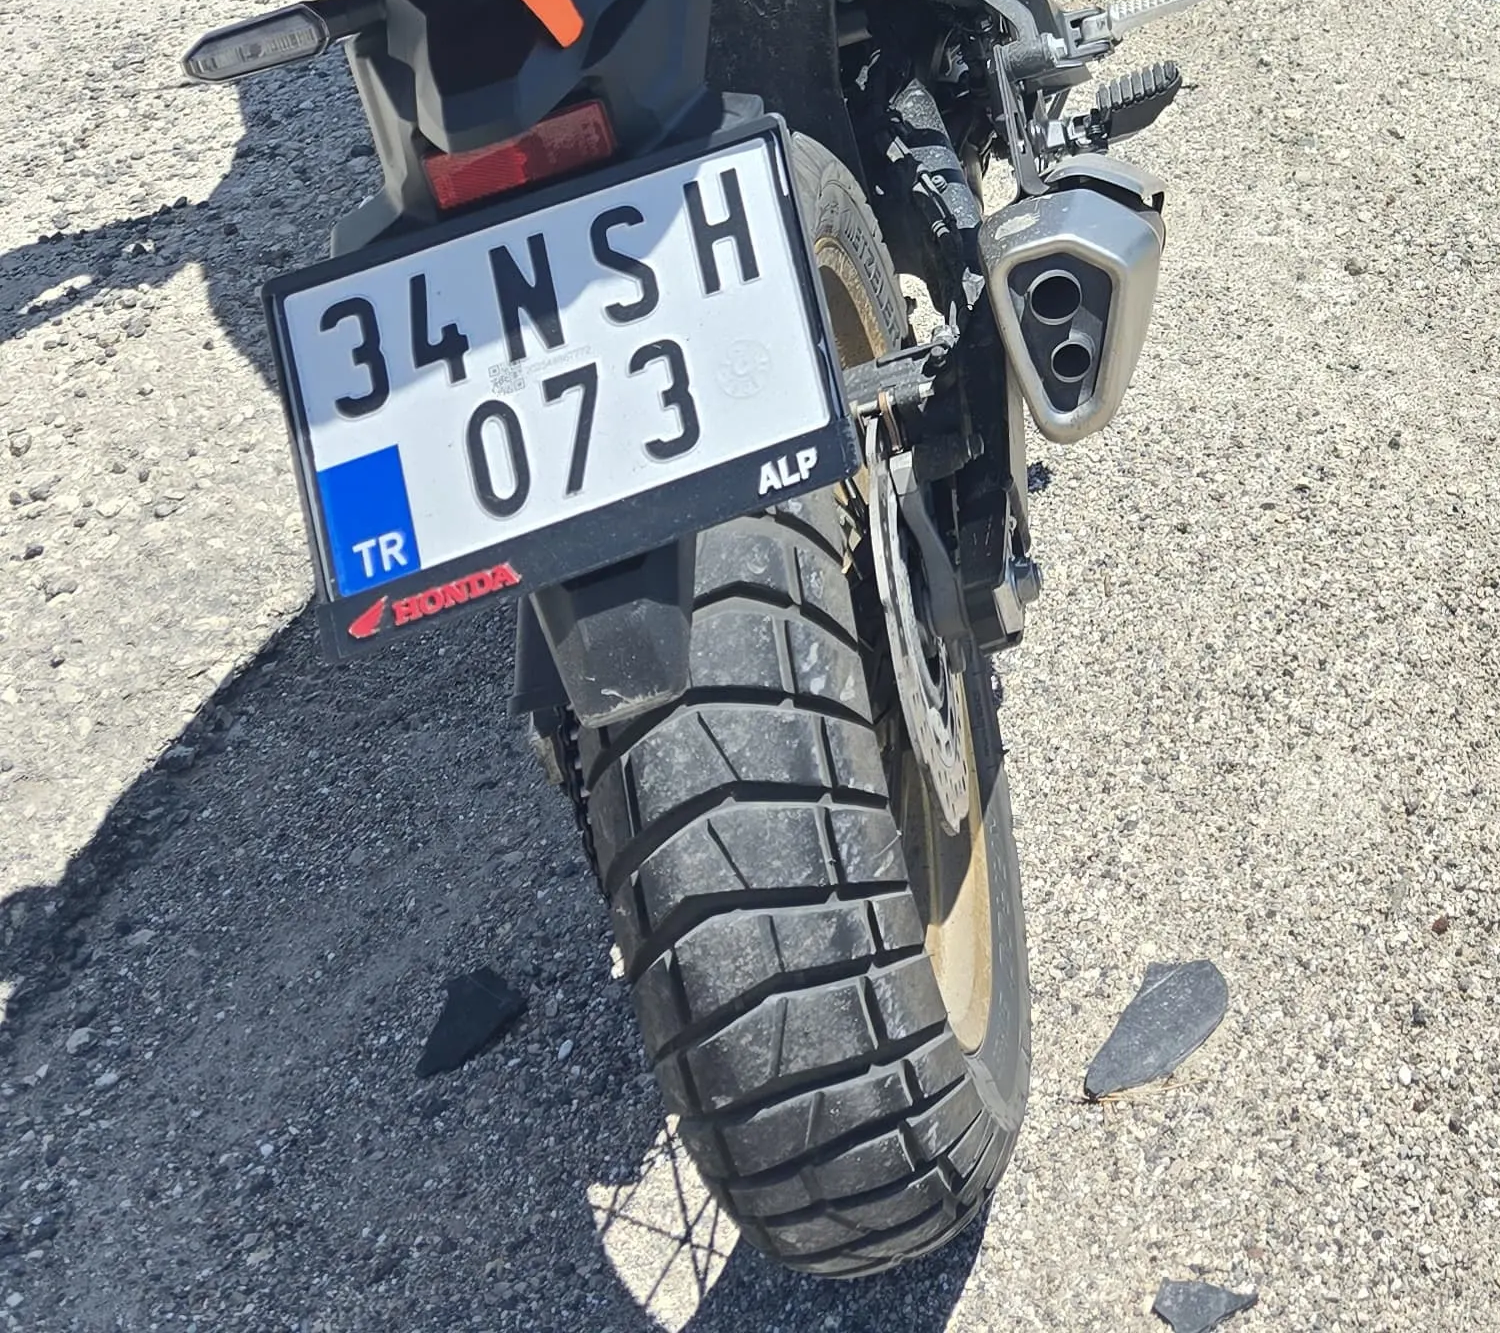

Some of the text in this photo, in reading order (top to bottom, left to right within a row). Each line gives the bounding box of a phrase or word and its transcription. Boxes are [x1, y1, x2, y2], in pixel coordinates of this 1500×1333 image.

[465, 339, 701, 519] 073
[758, 446, 819, 496] ALP
[352, 530, 408, 579] TR
[393, 561, 522, 626] HONDA
